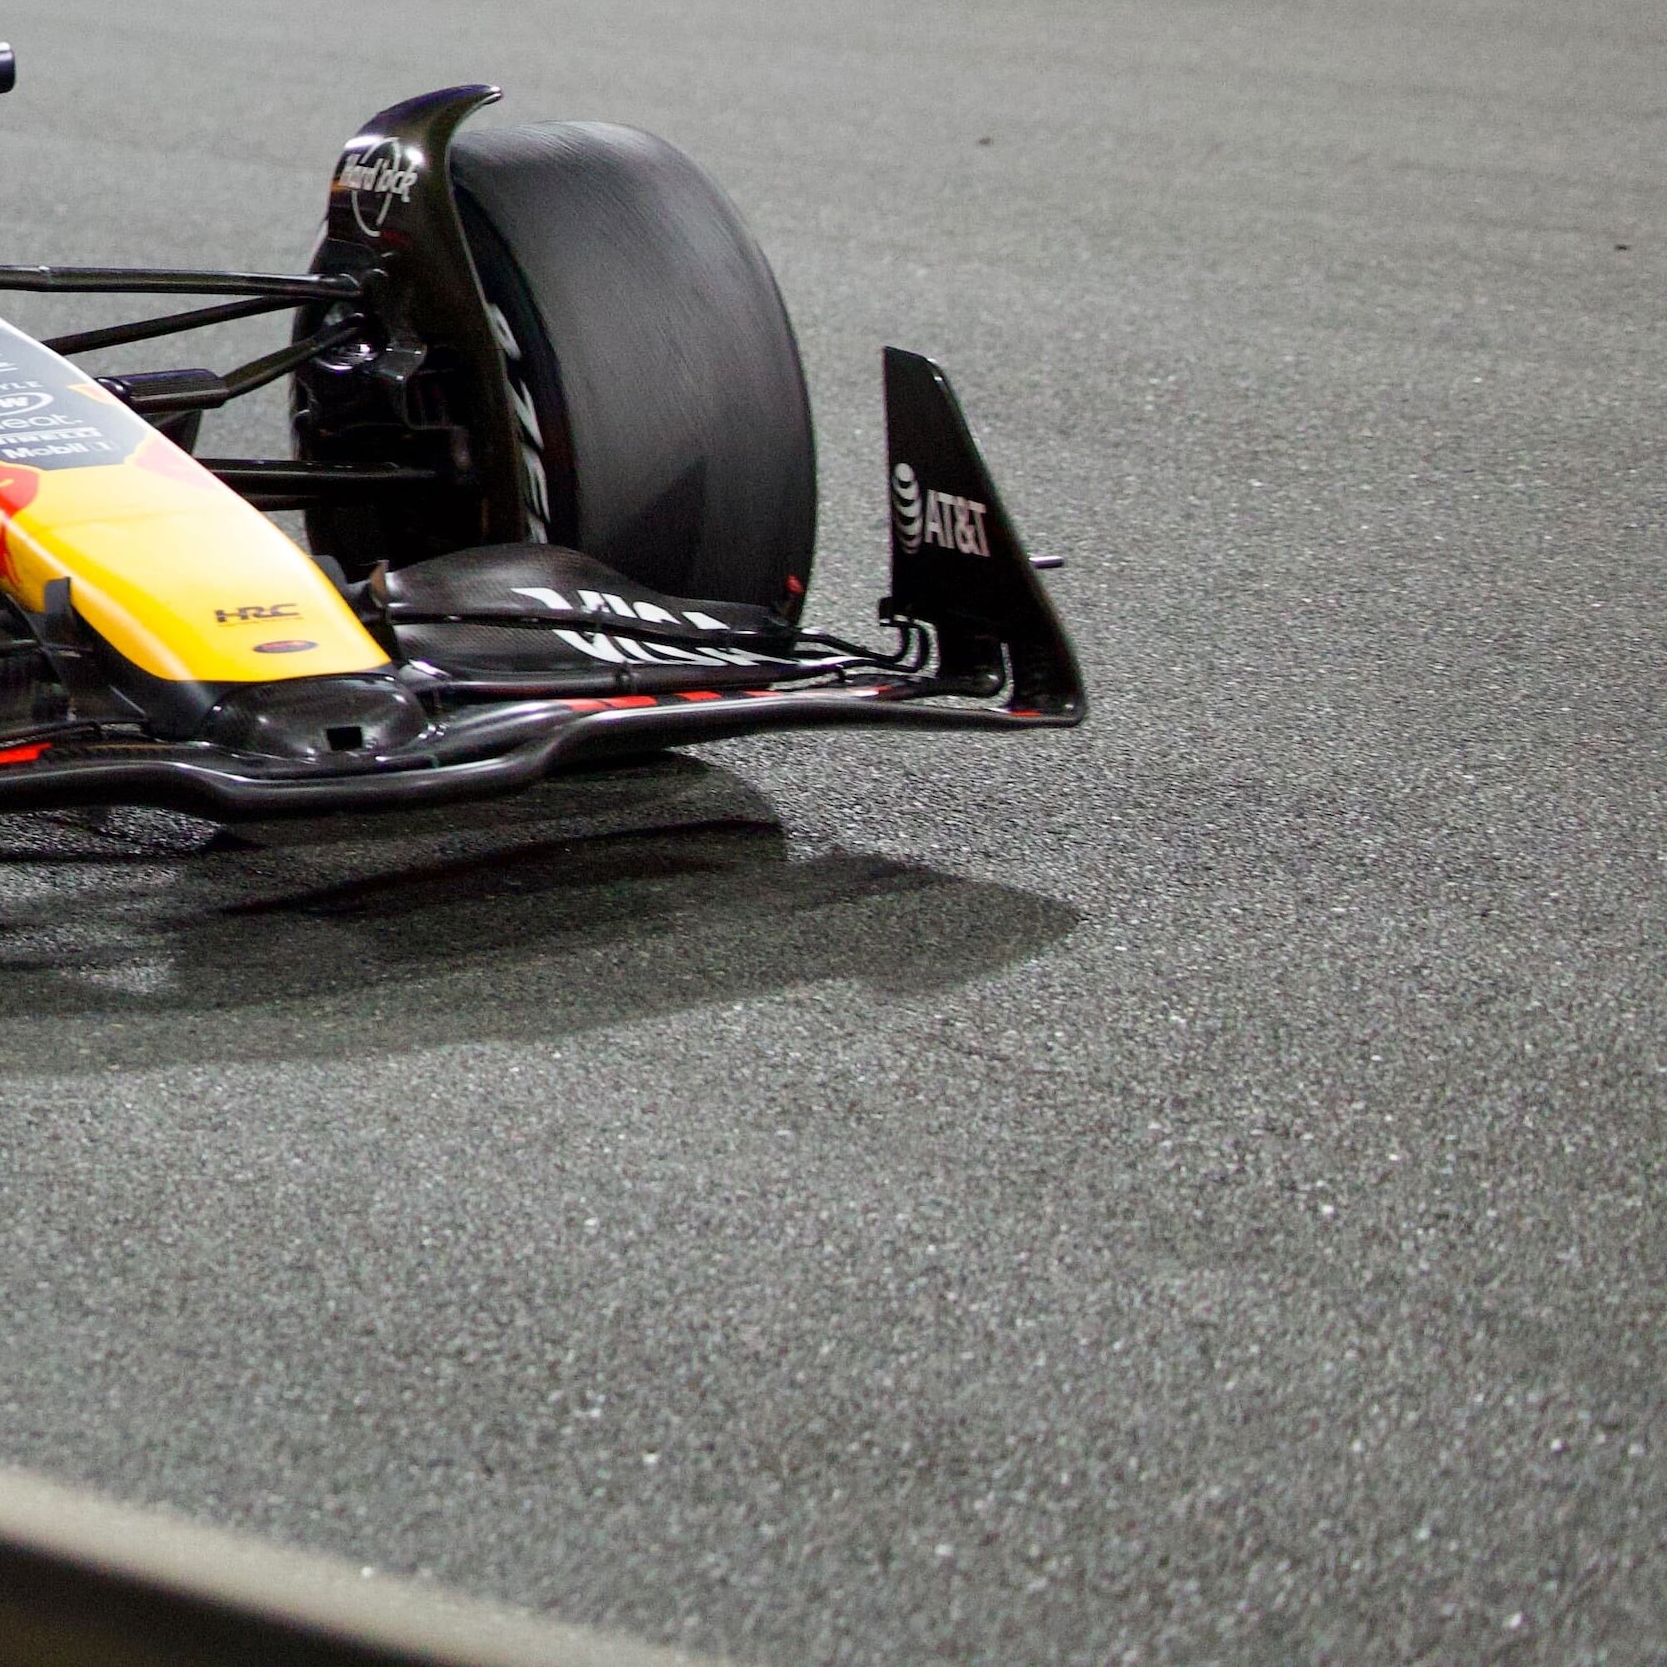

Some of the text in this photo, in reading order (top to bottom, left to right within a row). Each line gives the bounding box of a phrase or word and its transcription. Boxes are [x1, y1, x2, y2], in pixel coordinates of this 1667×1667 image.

[0, 442, 89, 460] Mobil
[924, 488, 991, 557] AT&T
[214, 603, 300, 623] HRC
